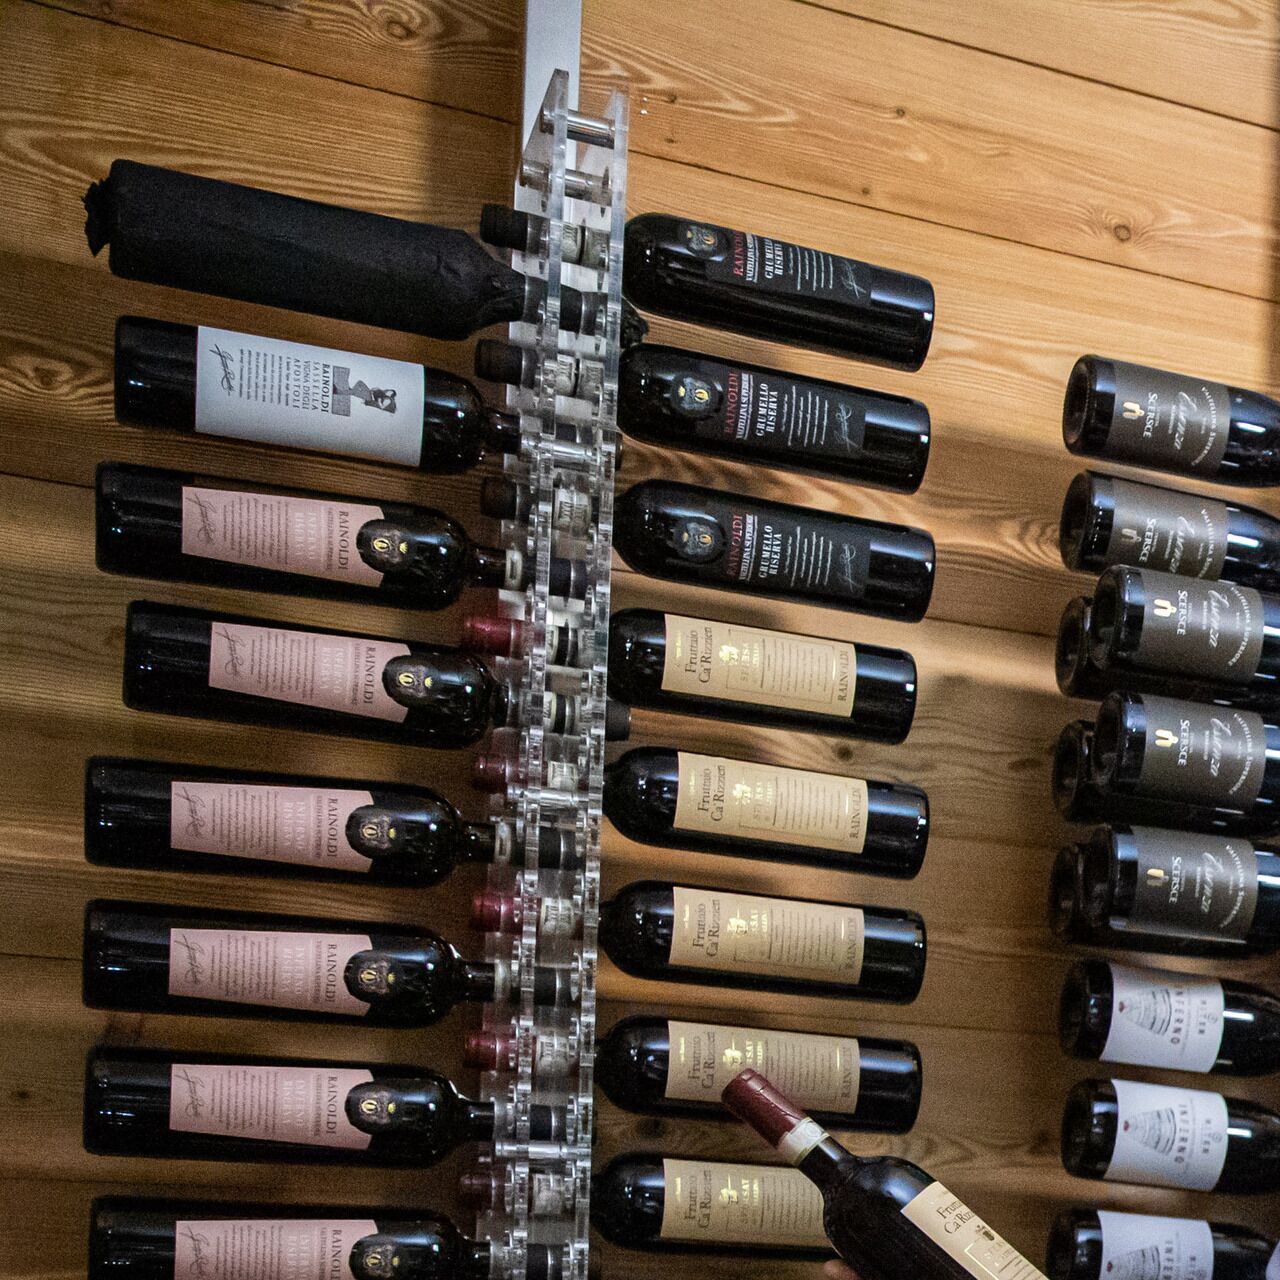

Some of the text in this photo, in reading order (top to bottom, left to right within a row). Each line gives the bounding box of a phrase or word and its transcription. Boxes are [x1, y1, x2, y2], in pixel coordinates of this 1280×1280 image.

[292, 358, 301, 409] APOSTOLI
[311, 362, 320, 411] SASSELLA
[320, 363, 331, 414] RAINOLDI
[724, 373, 740, 434] RAINOLDI
[756, 383, 769, 437] GRUMELLO
[766, 391, 778, 433] RISERVA
[337, 511, 349, 570] RAINOLDI
[727, 514, 743, 576] RAINOLDI
[759, 525, 773, 578] GRUMELLO
[770, 533, 782, 575] RISERVA
[363, 646, 376, 705] RAINOLDI
[838, 650, 848, 702] RAINOLDI
[327, 797, 338, 858] RAINOLDI
[327, 943, 337, 1004] RAINOLDI
[327, 1076, 337, 1136] RAINOLDI
